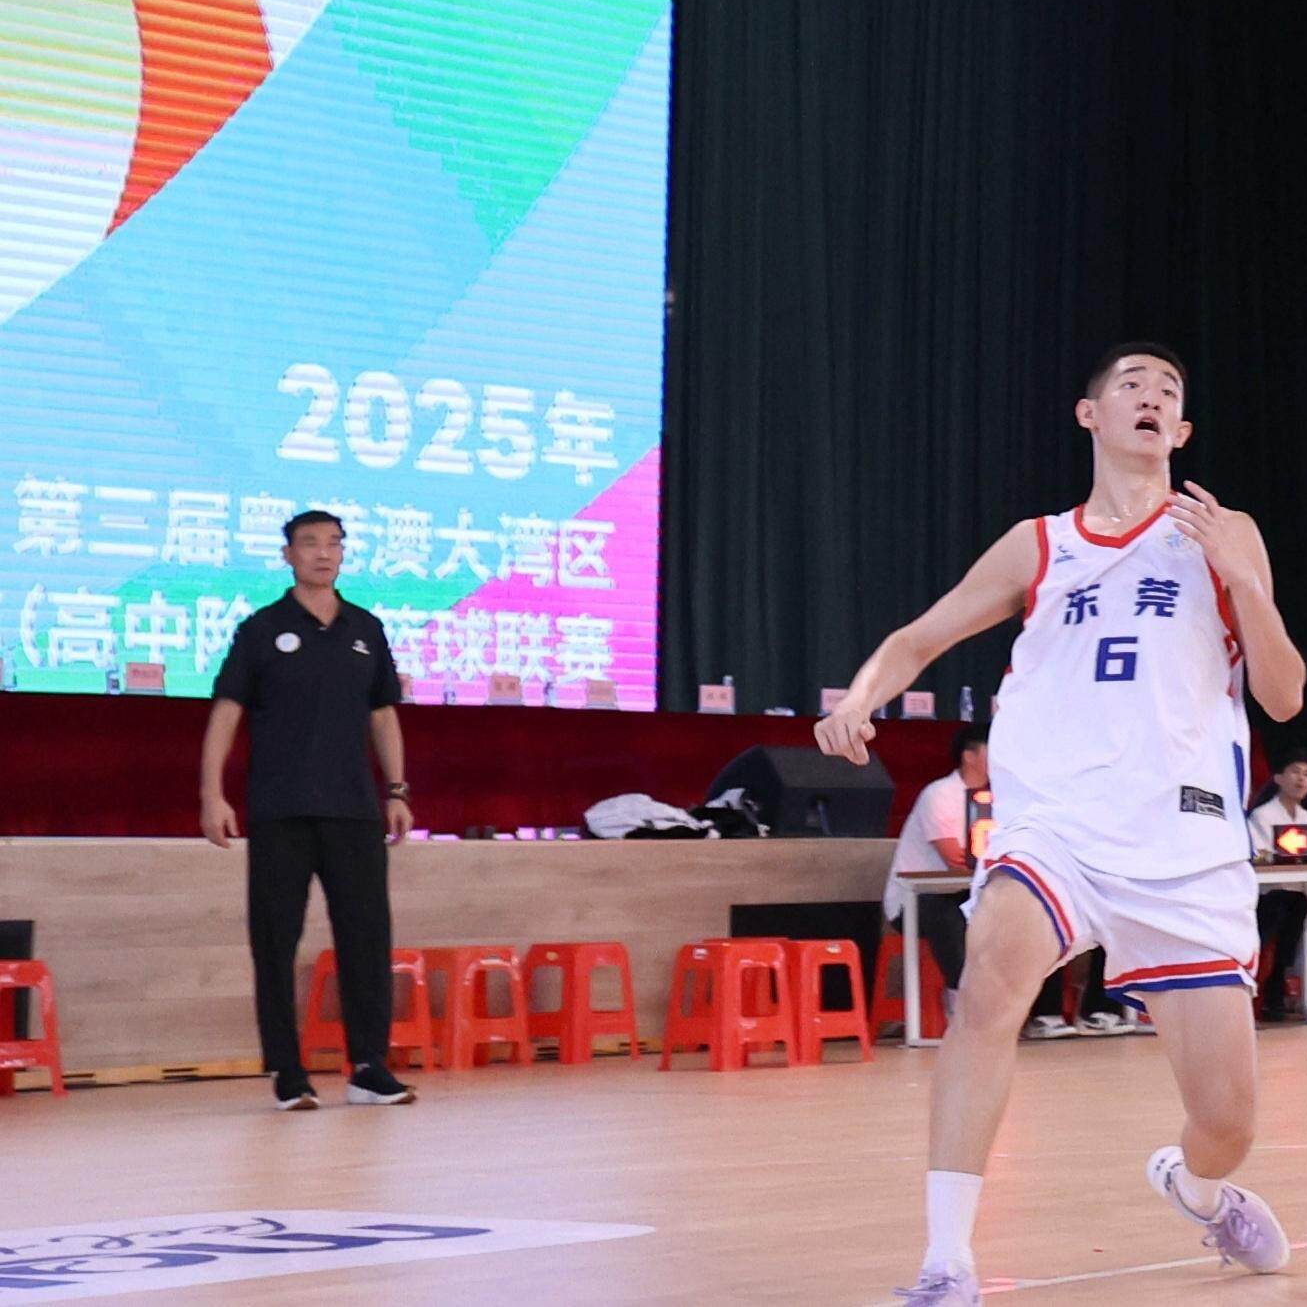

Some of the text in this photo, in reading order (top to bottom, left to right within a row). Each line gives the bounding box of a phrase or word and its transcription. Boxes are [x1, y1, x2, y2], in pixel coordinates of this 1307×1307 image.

[277, 362, 618, 486] 2025年
[20, 583, 614, 683] （高中阶篮球联赛
[1063, 577, 1181, 625] 东莞
[1094, 636, 1139, 682] 6
